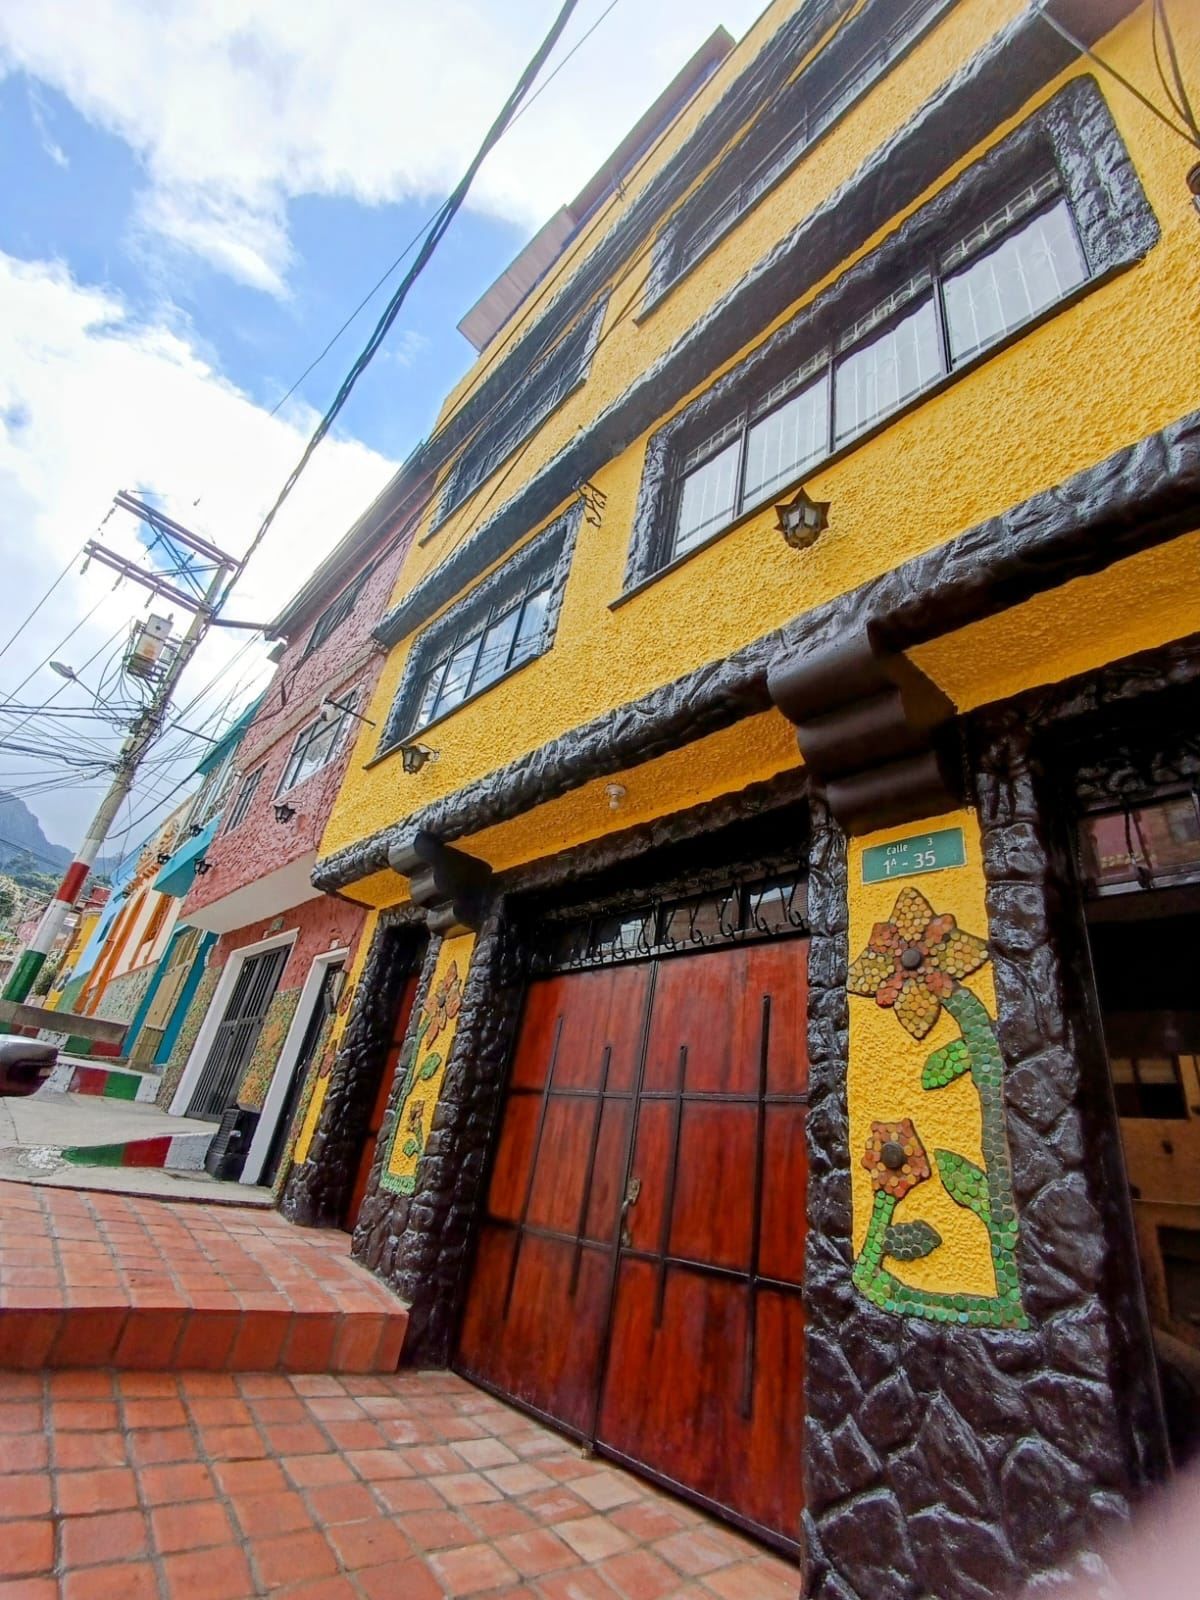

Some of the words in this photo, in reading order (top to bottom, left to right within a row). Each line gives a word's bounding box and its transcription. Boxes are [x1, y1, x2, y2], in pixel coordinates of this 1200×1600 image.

[886, 843, 908, 856] Calle
[927, 837, 933, 846] 3
[913, 850, 936, 869] 35
